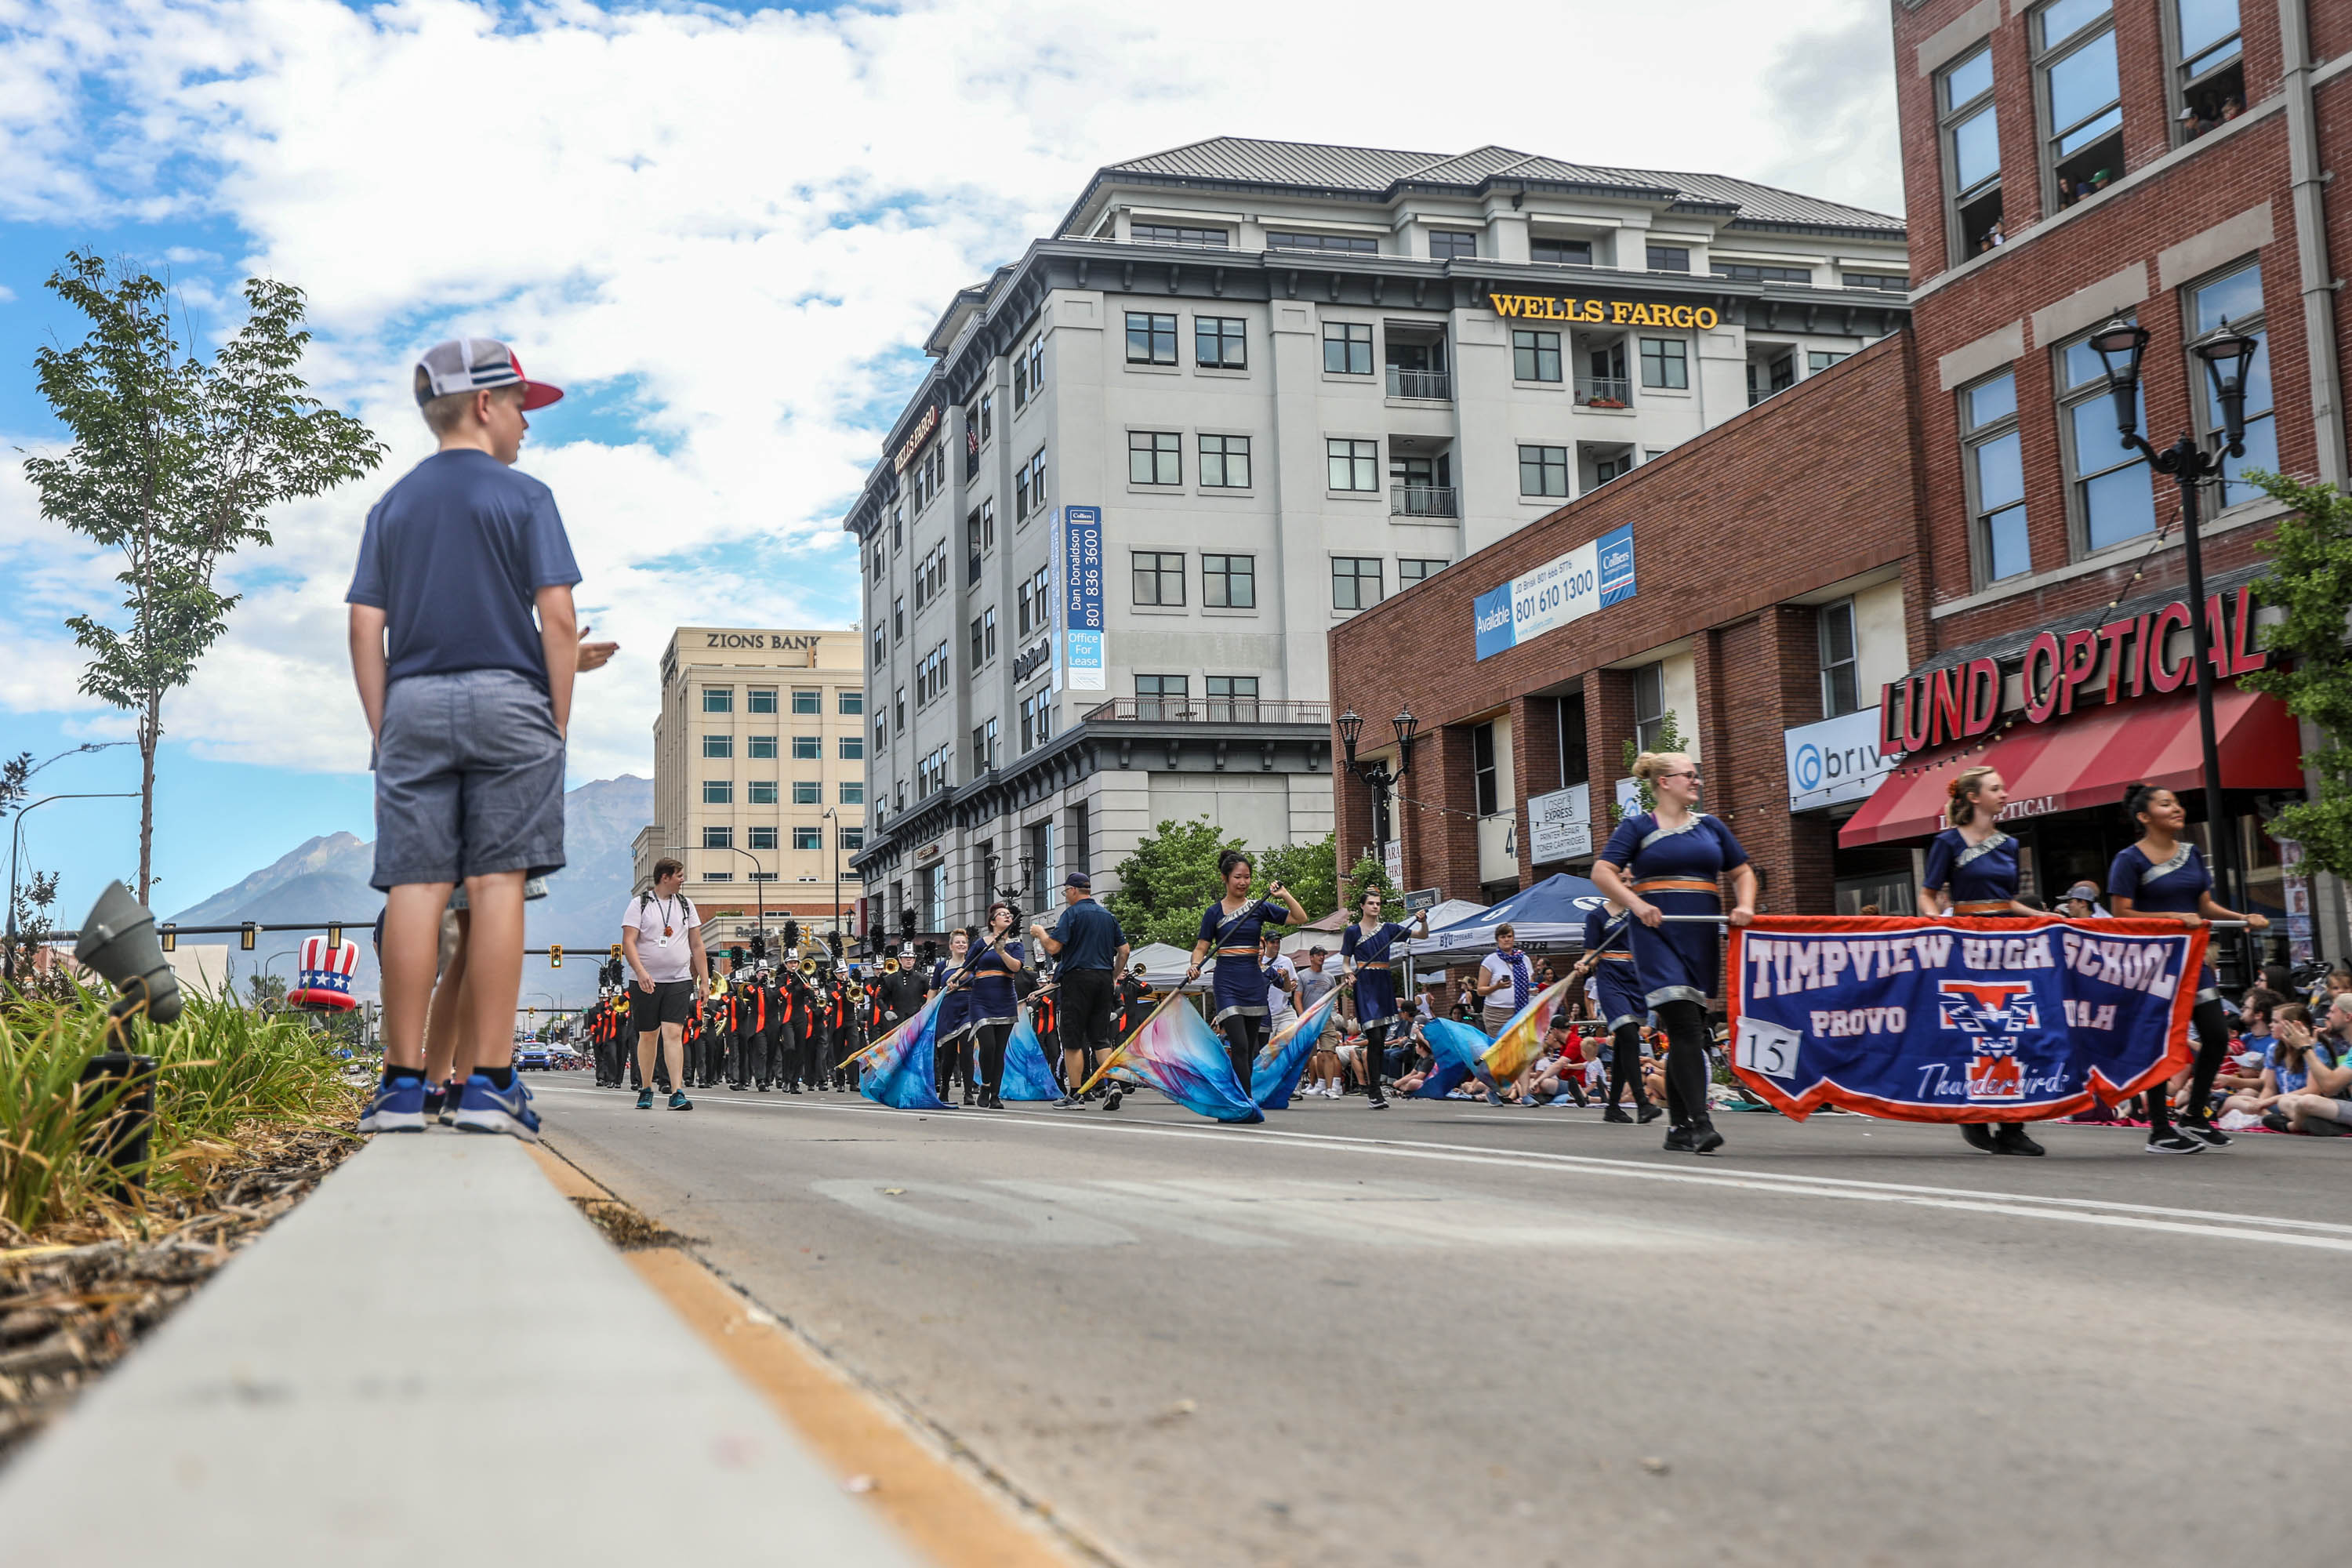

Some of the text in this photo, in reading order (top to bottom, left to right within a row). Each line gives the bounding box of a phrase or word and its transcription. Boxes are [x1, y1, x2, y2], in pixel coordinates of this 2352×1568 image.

[1490, 293, 1719, 329] WELLS FARGO
[895, 405, 935, 474] WELLS FARGO
[1069, 528, 1081, 611] Dan Donaldson
[1603, 552, 1630, 569] Colliers
[1084, 529, 1099, 627] 801 836 3600
[1515, 596, 1536, 623] 801
[1539, 585, 1559, 612] 610
[1563, 569, 1593, 601] 1300
[1476, 605, 1510, 636] Available
[707, 633, 822, 649] ZIONS BANK
[1069, 633, 1098, 643] Office
[1076, 644, 1092, 655] For
[1069, 657, 1098, 666] Lease
[1880, 586, 2268, 757] LUND OPTICAL
[1544, 806, 1573, 822] EXPRESS
[1992, 796, 2058, 821] PTICAL
[1537, 842, 1553, 852] TONER
[1554, 835, 1585, 849] CARTRIDGES
[1540, 826, 1580, 841] PRINTER REPAIR
[1439, 932, 1454, 947] BYU
[1748, 933, 2177, 1000] TIMPVIEW HIGH SCHOOL
[1810, 1006, 1907, 1038] PROVO
[1747, 1034, 1789, 1073] 15
